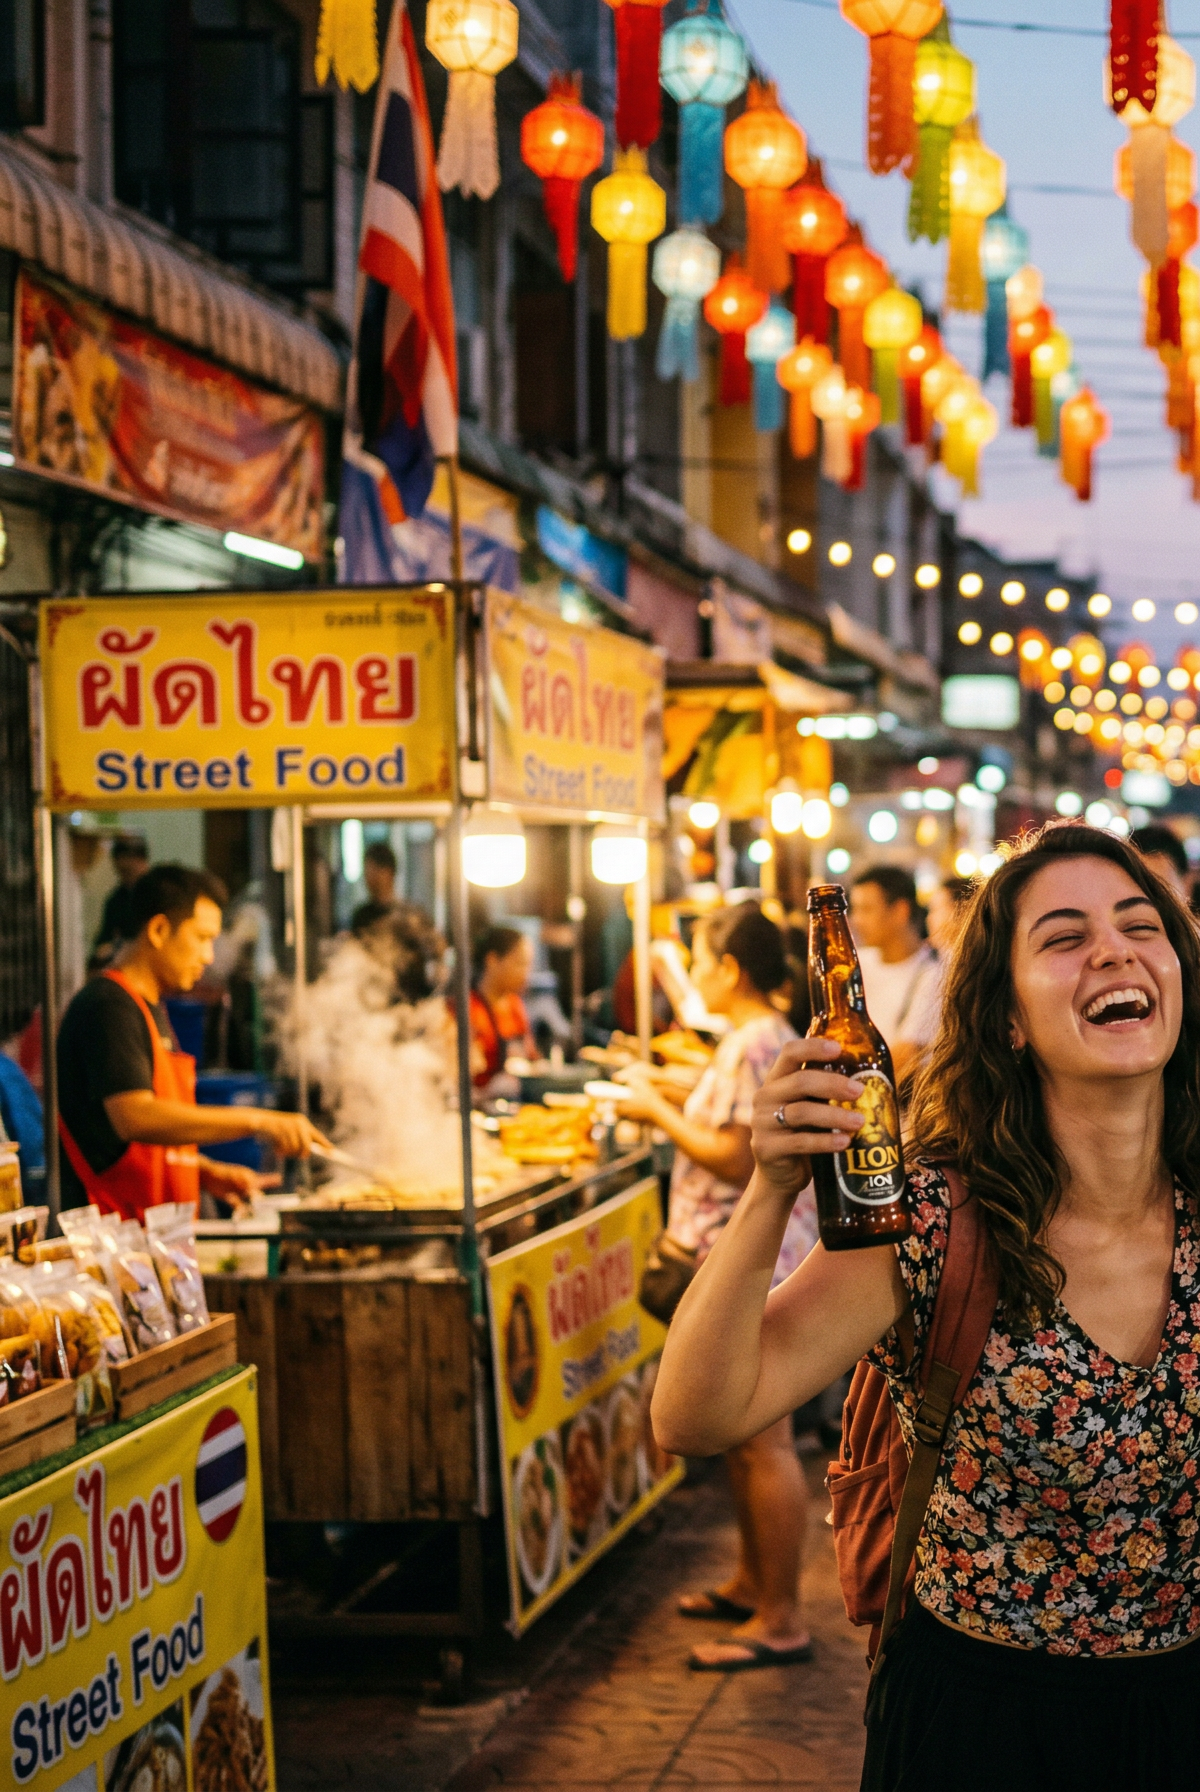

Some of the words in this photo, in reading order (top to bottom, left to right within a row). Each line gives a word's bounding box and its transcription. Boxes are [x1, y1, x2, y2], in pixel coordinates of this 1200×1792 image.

[79, 618, 418, 730] ผัดไทย
[96, 749, 252, 791] Street
[275, 745, 406, 788] Food
[845, 1144, 899, 1175] LION
[0, 1464, 186, 1680] ผัดไทย
[12, 1655, 121, 1772] Street
[131, 1593, 205, 1704] Food
